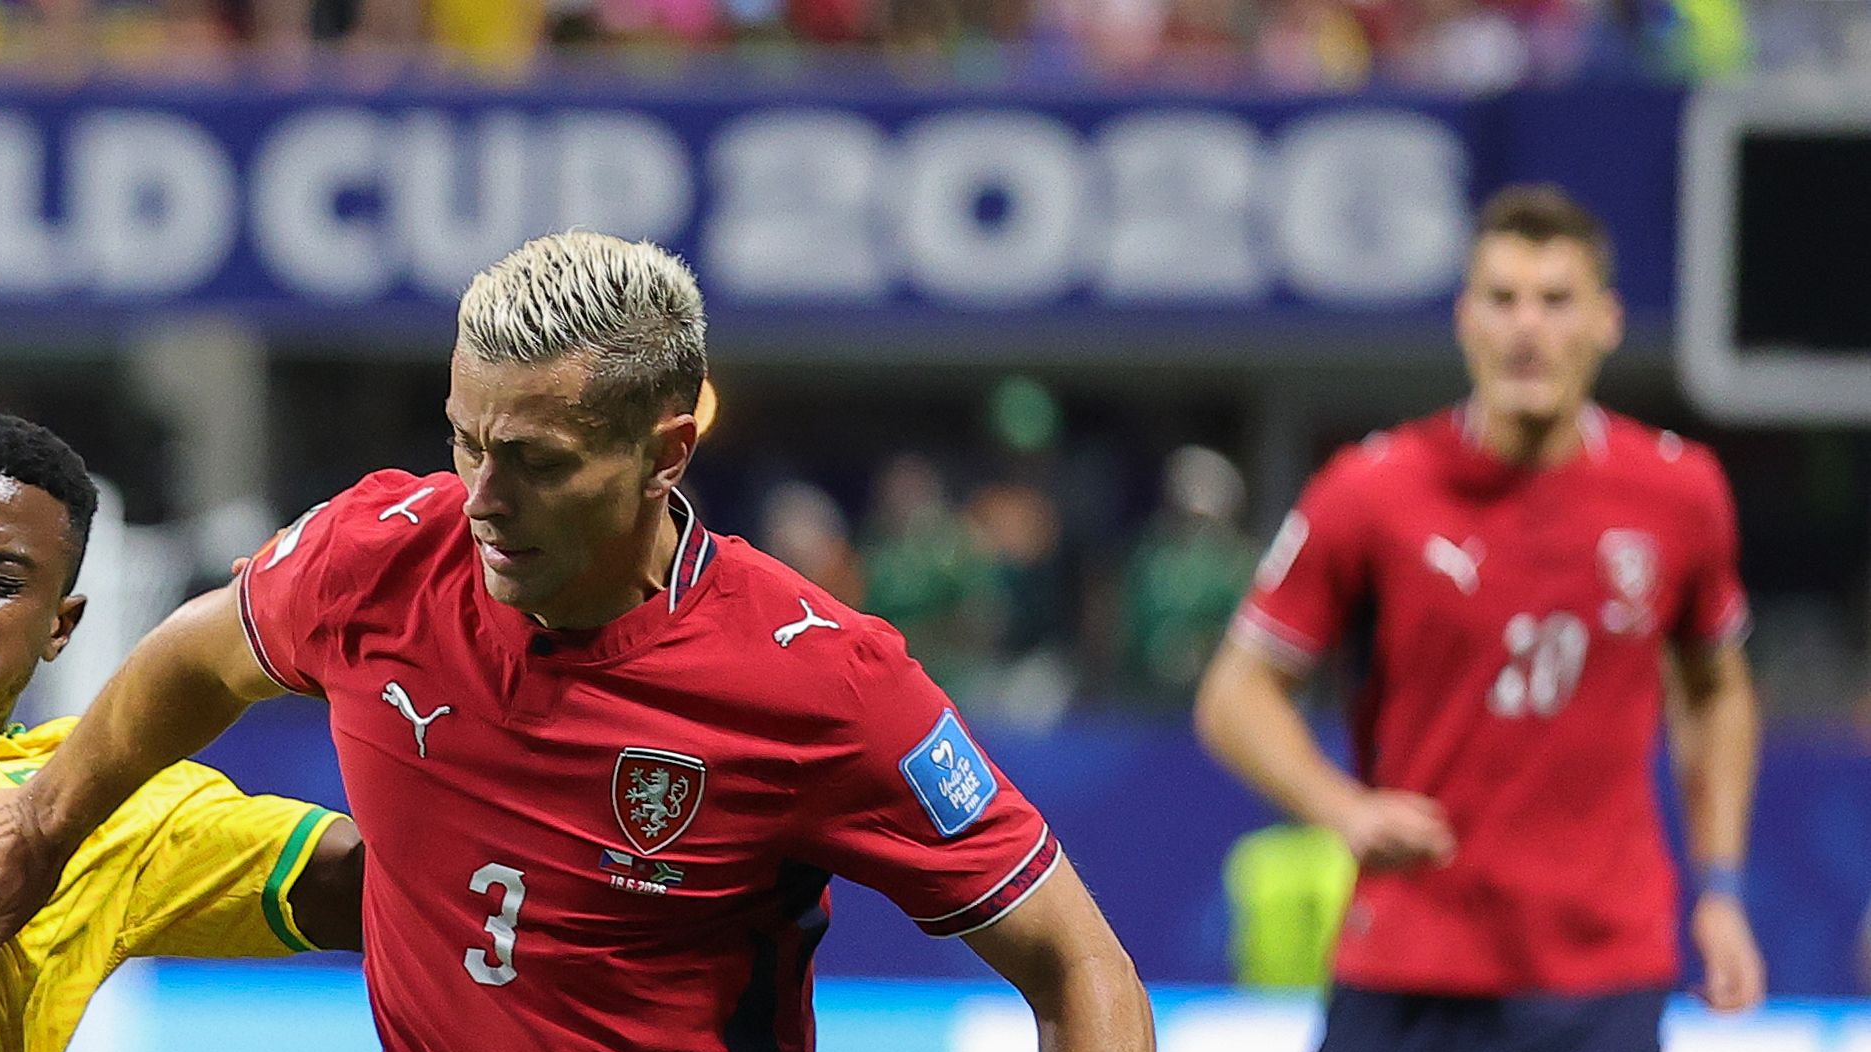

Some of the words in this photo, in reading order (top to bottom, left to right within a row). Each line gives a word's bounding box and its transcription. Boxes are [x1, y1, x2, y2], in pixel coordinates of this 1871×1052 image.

[248, 103, 695, 297] CUP
[705, 103, 1465, 306] 2026
[948, 770, 981, 810] PEACE
[463, 862, 525, 986] 3
